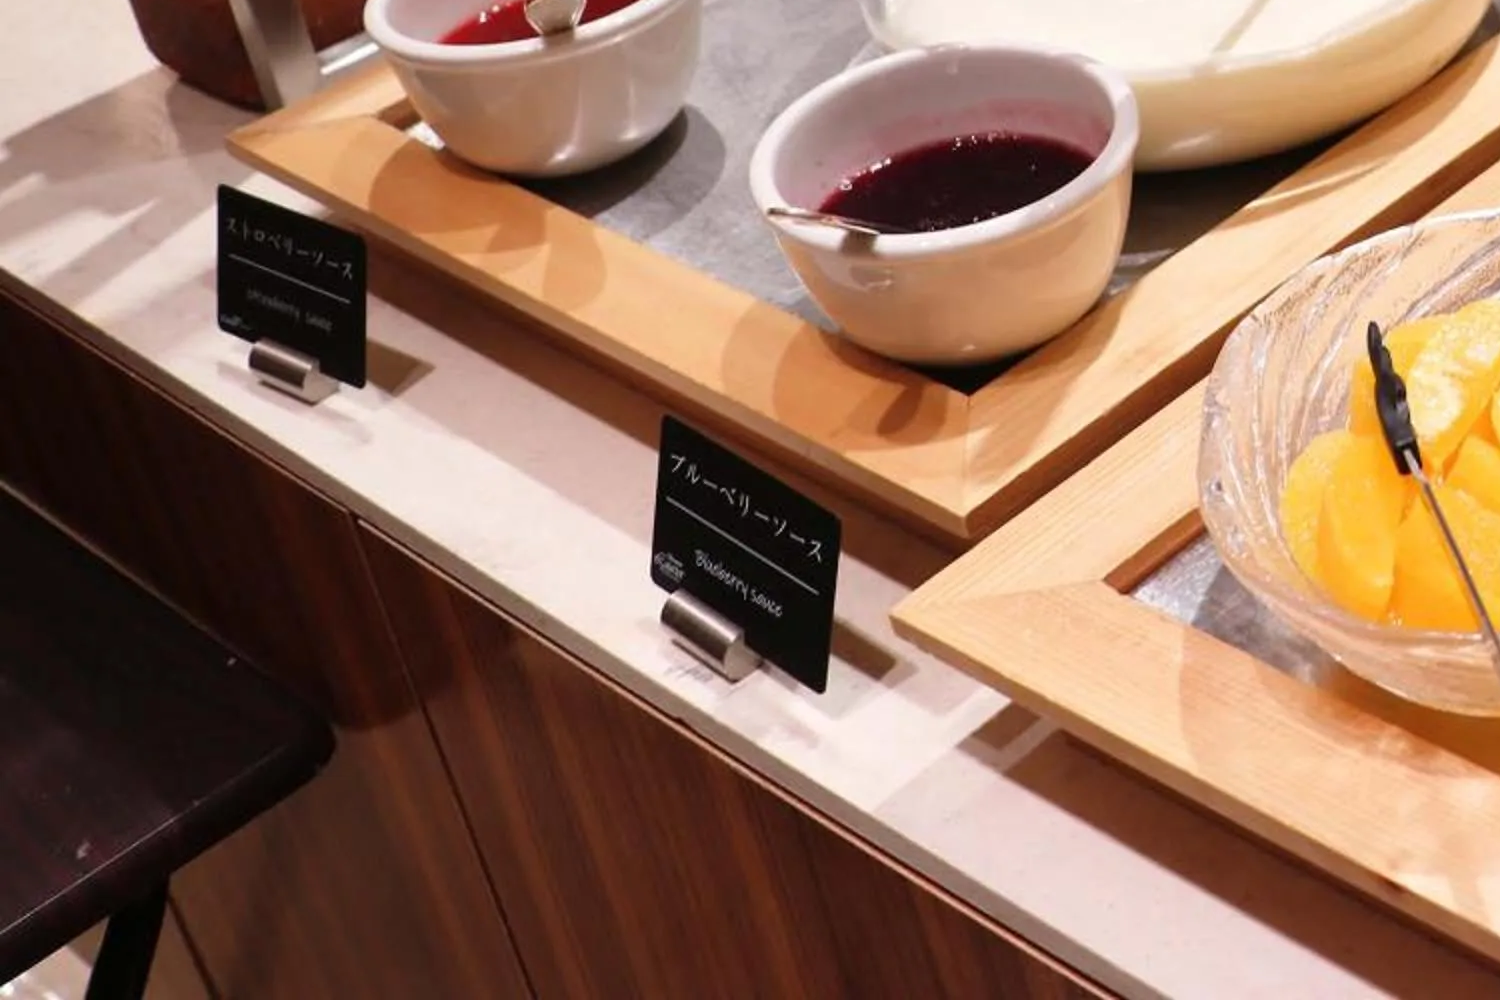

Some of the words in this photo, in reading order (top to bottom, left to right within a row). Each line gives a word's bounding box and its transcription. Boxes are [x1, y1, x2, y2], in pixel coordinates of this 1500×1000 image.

[670, 453, 823, 563] ブルーベリーソース
